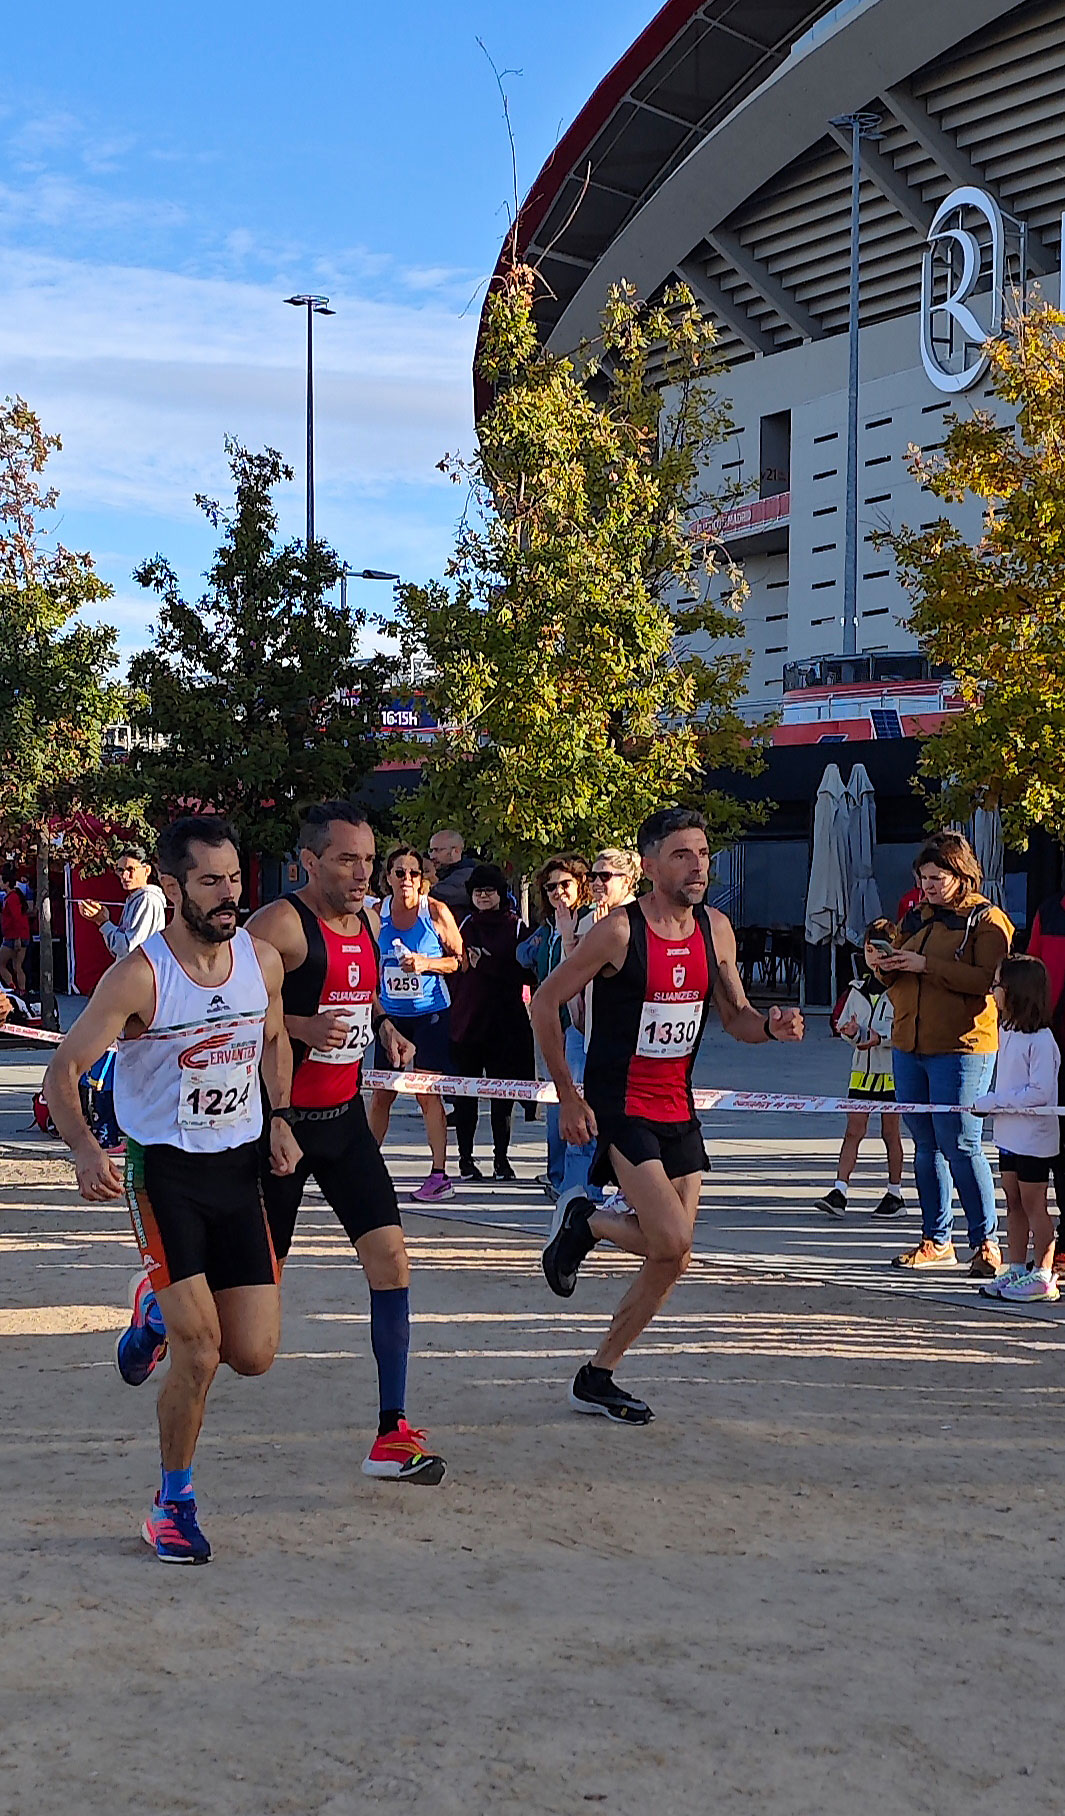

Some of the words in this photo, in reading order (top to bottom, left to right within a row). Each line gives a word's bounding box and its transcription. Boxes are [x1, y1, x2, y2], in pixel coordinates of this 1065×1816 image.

[381, 711, 418, 726] 16:15h
[387, 977, 420, 991] 1259
[653, 990, 700, 1001] SUANZES
[644, 1020, 696, 1045] 1330
